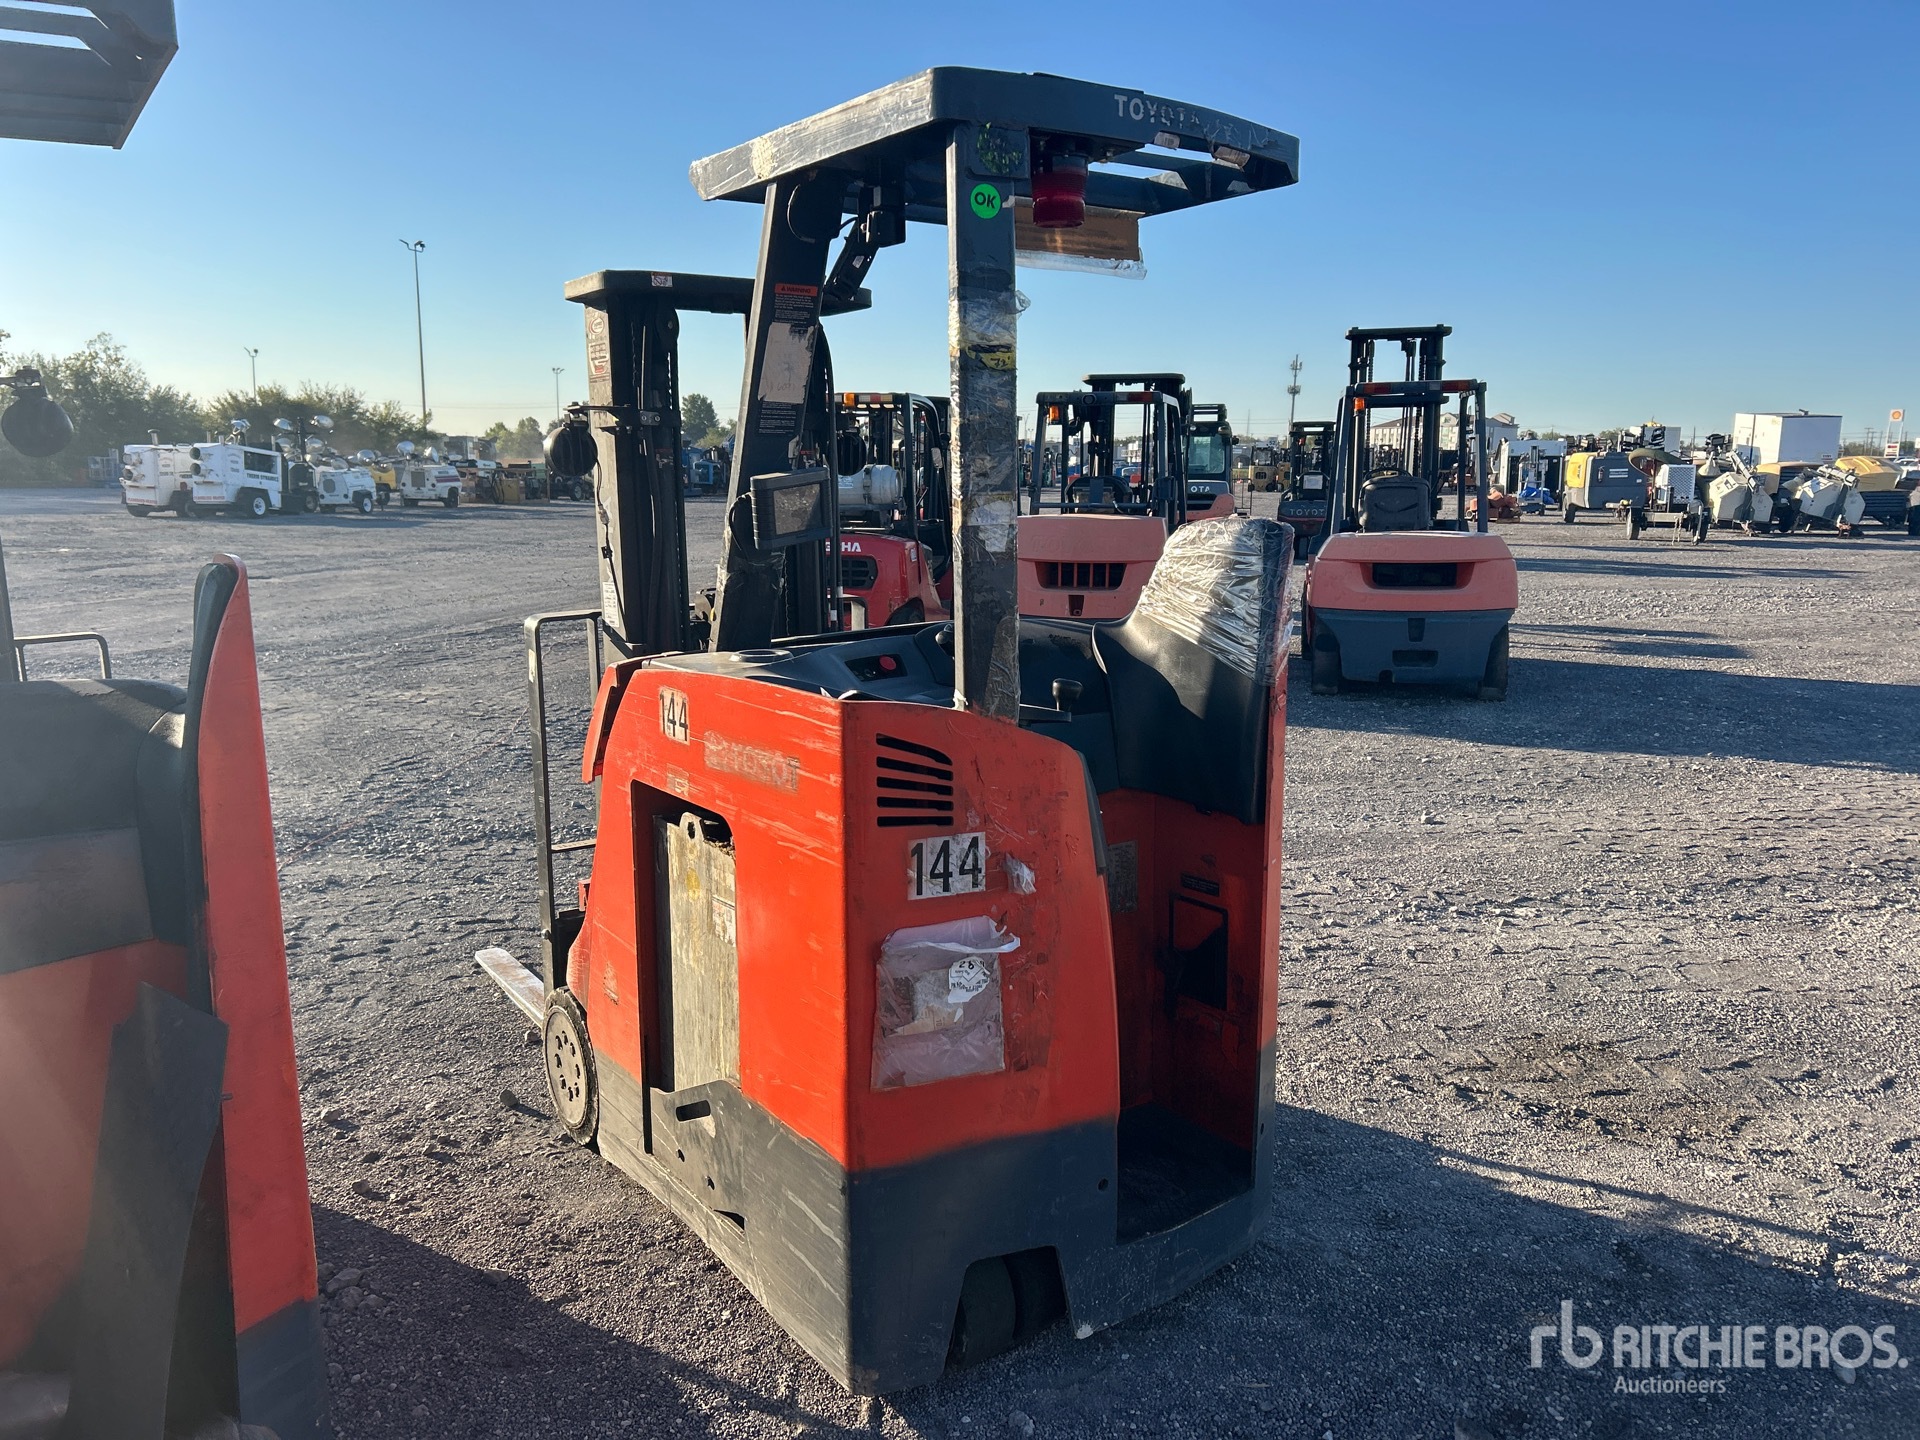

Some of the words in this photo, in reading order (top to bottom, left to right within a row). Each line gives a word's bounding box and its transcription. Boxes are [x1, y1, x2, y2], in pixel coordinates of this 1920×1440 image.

[974, 192, 996, 209] OK
[786, 286, 811, 294] WARNING
[1289, 508, 1326, 516] TOYOT
[659, 691, 689, 742] 144
[910, 836, 982, 896] 144
